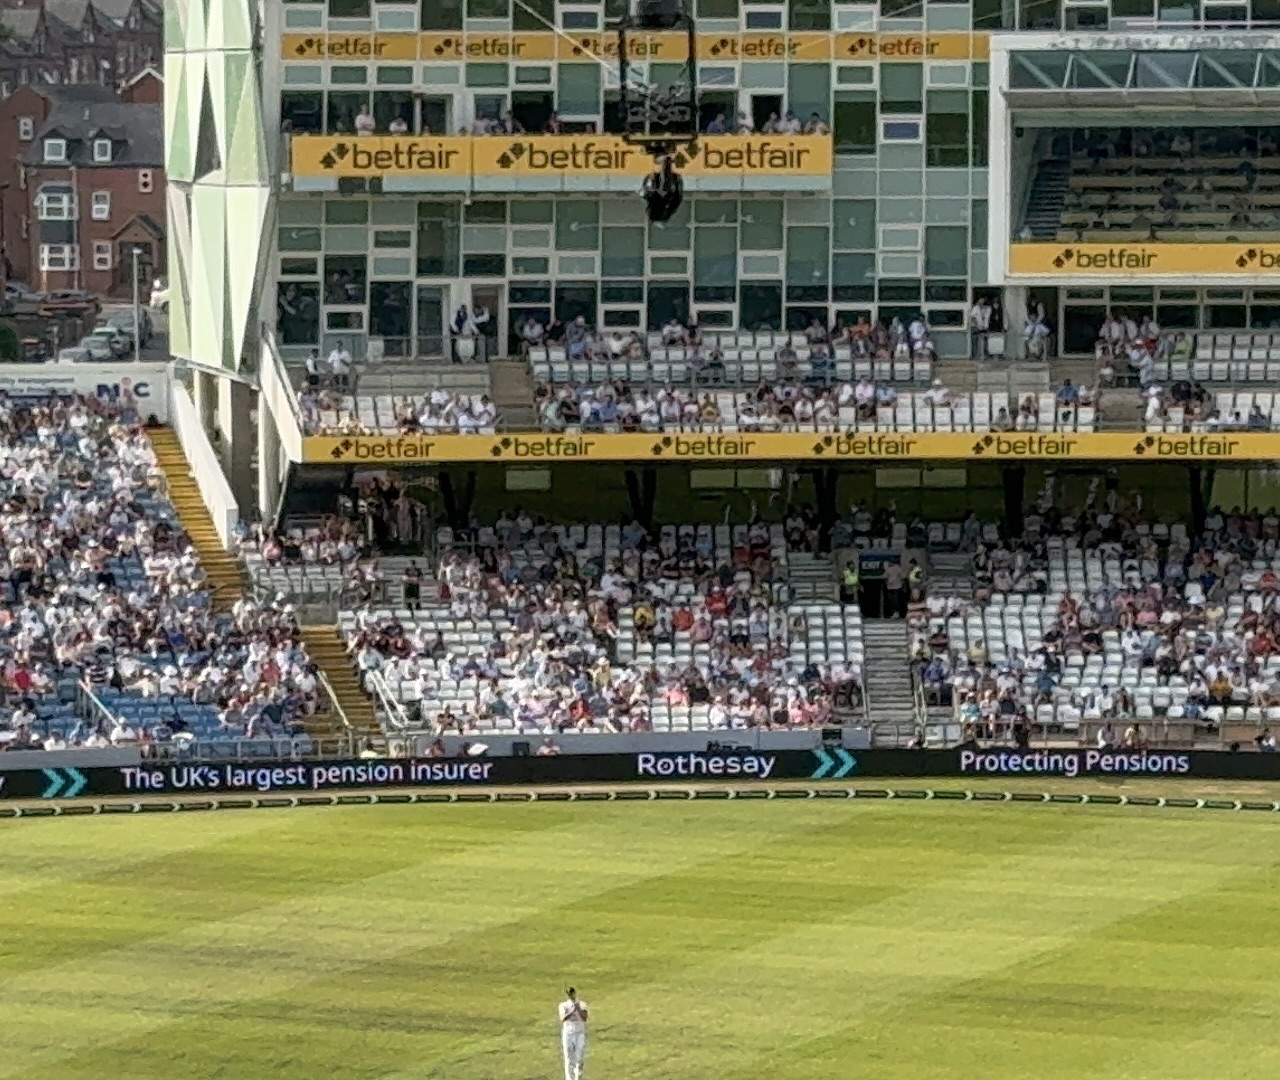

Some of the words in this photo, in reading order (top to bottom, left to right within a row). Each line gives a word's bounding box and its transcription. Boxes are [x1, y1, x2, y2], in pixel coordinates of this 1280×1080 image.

[315, 37, 387, 57] betfair
[454, 37, 526, 57] betfair
[592, 38, 663, 56] befair
[729, 36, 801, 57] betfair
[868, 35, 940, 56] betfair
[352, 142, 460, 170] betfair
[528, 142, 634, 169] betfair
[703, 141, 810, 169] betfair
[1076, 247, 1158, 269] betfair
[354, 438, 434, 459] betfair
[514, 438, 594, 458] betfair
[674, 437, 755, 458] betfair
[836, 437, 916, 458] betfair
[996, 437, 1077, 458] betfair
[1157, 437, 1238, 458] betfair
[638, 752, 776, 779] Rothesay
[960, 750, 1078, 777] Protecting
[1086, 751, 1189, 773] Pensions
[121, 766, 164, 790] The
[226, 762, 306, 793] largest
[312, 760, 405, 789] pension
[411, 757, 494, 782] insurer
